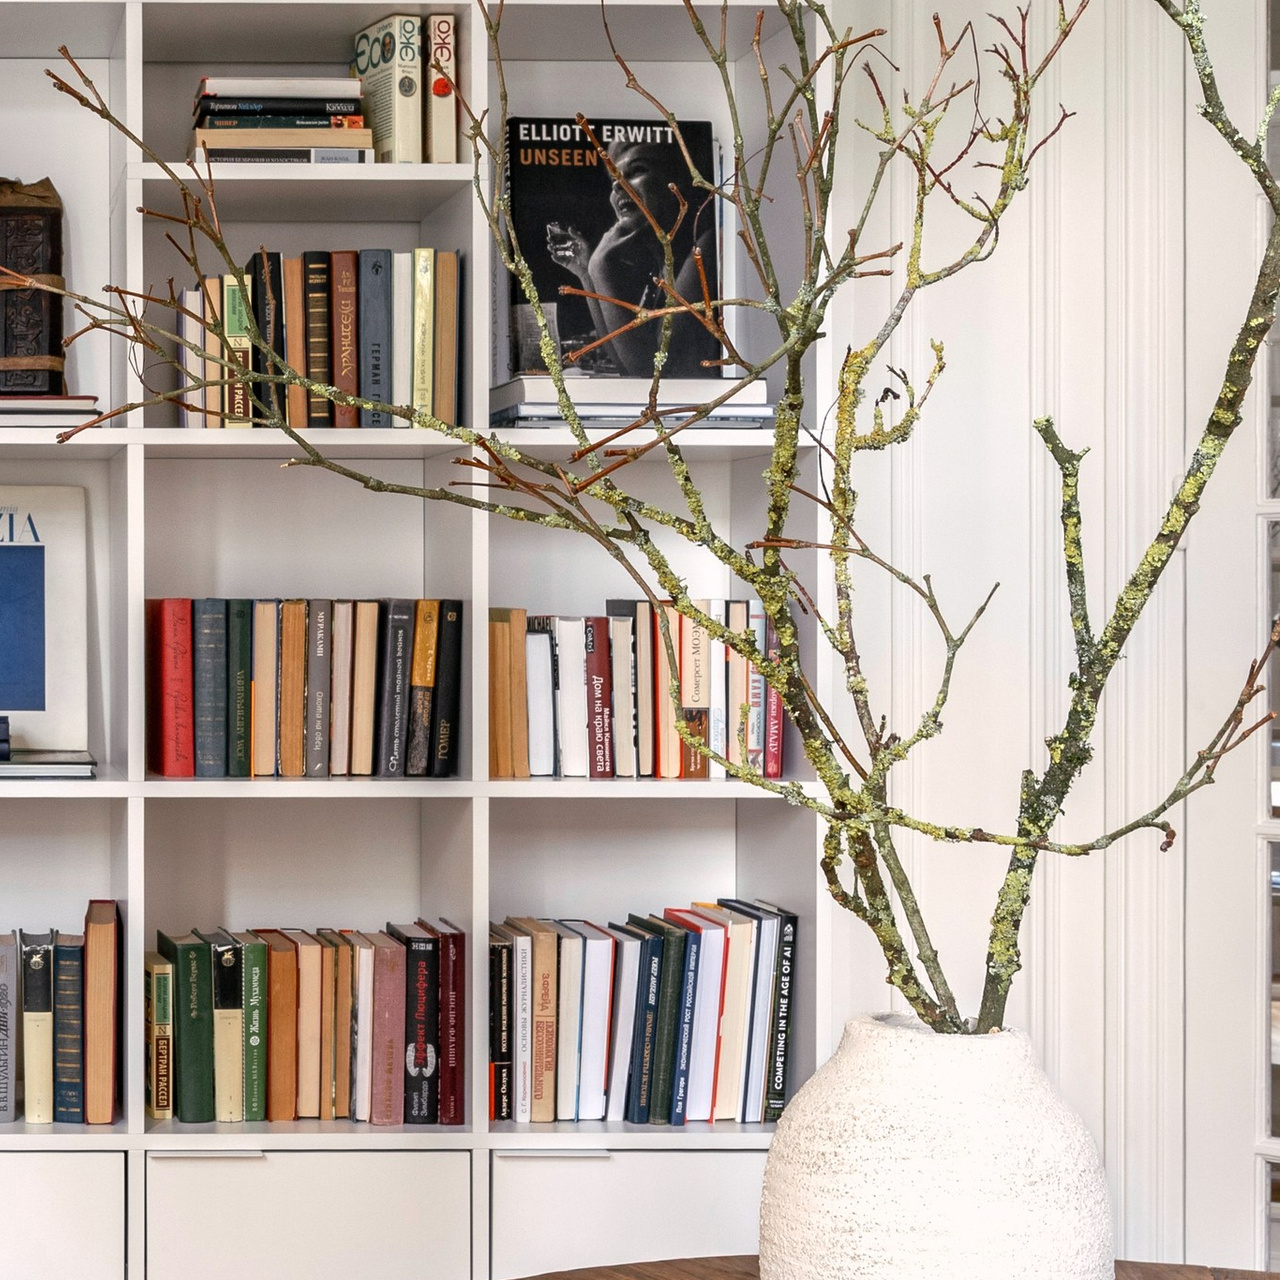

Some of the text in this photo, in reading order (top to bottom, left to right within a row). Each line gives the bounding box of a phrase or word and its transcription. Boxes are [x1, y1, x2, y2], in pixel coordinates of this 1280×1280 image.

[399, 19, 416, 62] ЭКО
[433, 19, 452, 62] ЭКО
[325, 103, 355, 113] Каббала
[519, 123, 676, 144] ELLIOTT ERWITT
[520, 148, 597, 166] UNSEEN
[341, 300, 355, 378] ХРАНИТЕЛИ
[371, 343, 381, 385] ГЕРМАН
[234, 389, 244, 418] РАССЕЛ
[1, 503, 19, 513] mia
[313, 611, 325, 751] МУРАКАМИ Охота на овец
[395, 665, 404, 696] тайной
[690, 658, 703, 703] Сомерсет
[751, 679, 762, 708] КАМЮ
[393, 702, 403, 736] столетий
[422, 691, 431, 727] ПРИГОВОР
[592, 675, 605, 772] Дом на краю света
[438, 719, 451, 760] ГОМЕР
[603, 733, 611, 772] Каннингем
[769, 717, 779, 755] АМАДУ
[688, 943, 698, 971] ИМПЕРИИ
[781, 959, 791, 973] OF
[782, 947, 792, 958] AI
[249, 966, 261, 1033] Жизнь Мухаммеда
[415, 960, 427, 1021] Люцифера
[647, 956, 659, 1006] РОБЕР АМБЕЛЕН
[683, 972, 695, 1008] РОССИЙСКОЙ
[779, 976, 790, 997] AGE
[683, 1008, 692, 1023] РОСТ
[777, 1021, 787, 1031] IN
[778, 999, 788, 1018] THE
[414, 1023, 426, 1066] Эффект
[448, 991, 457, 1067] ИОСИФ ФЛАВИЙ
[544, 1020, 555, 1072] ПСИХОЛОГИЯ
[678, 1023, 690, 1071] ЭКОНОМИЧЕСКИЙ
[158, 1039, 169, 1107] БЕРТРАН РАССЕЛ
[534, 1020, 544, 1100] БЕССОЗНАТЕЛЬНОГО
[773, 1032, 787, 1090] COMPETING
[410, 1092, 420, 1117] Филип
[420, 1080, 429, 1117] Зимбардо
[677, 1077, 686, 1100] Грегори
